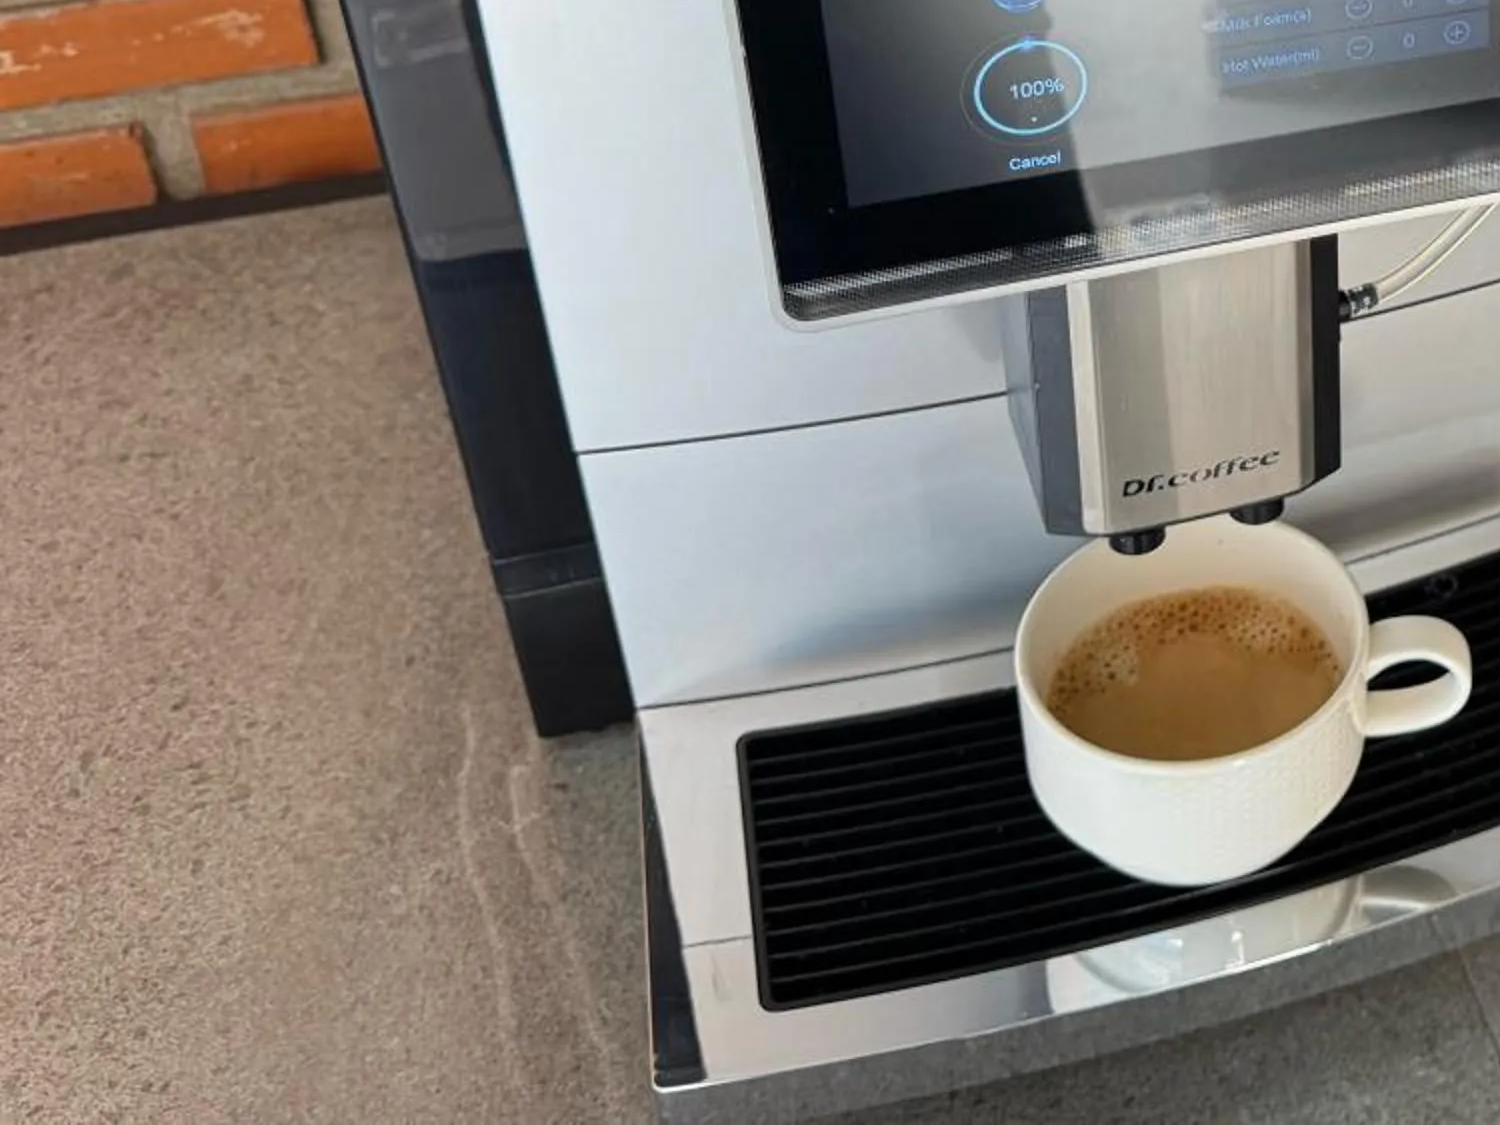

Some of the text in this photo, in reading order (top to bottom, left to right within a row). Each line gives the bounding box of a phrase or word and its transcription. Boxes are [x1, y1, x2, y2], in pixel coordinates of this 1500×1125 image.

[1403, 33, 1416, 49] 0
[1008, 77, 1066, 100] 100%
[1008, 151, 1062, 172] Cancel
[1121, 449, 1281, 498] Dr.coffee
